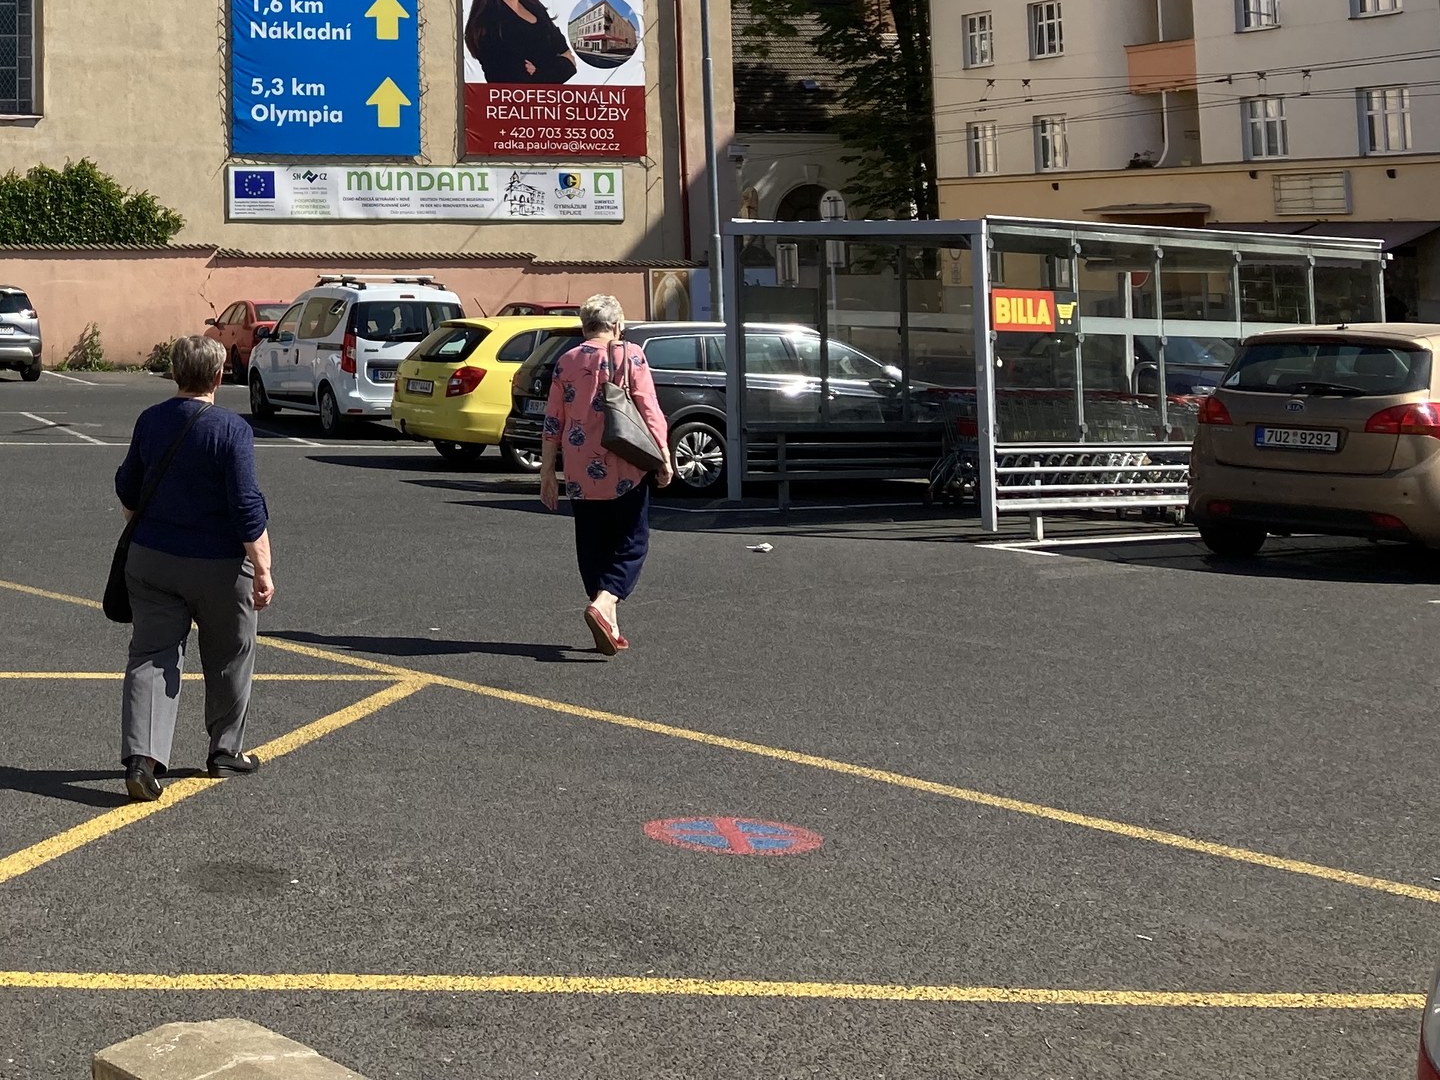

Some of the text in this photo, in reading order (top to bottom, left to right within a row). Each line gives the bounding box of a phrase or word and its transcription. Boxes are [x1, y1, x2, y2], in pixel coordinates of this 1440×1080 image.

[250, 21, 352, 40] Nákladní
[250, 78, 325, 98] 5,3 km
[488, 88, 627, 104] PROFESIONÁLNÍ
[250, 104, 343, 128] Olympia
[486, 104, 630, 121] REALITNÍ SLUŽBY
[510, 127, 535, 138] 420
[538, 128, 561, 139] 703
[564, 128, 587, 140] 353
[590, 128, 614, 140] 003
[494, 140, 620, 152] radka.paulova@kwcz.cz
[995, 296, 1052, 326] BILLA
[1266, 430, 1331, 446] 7U2 9292
